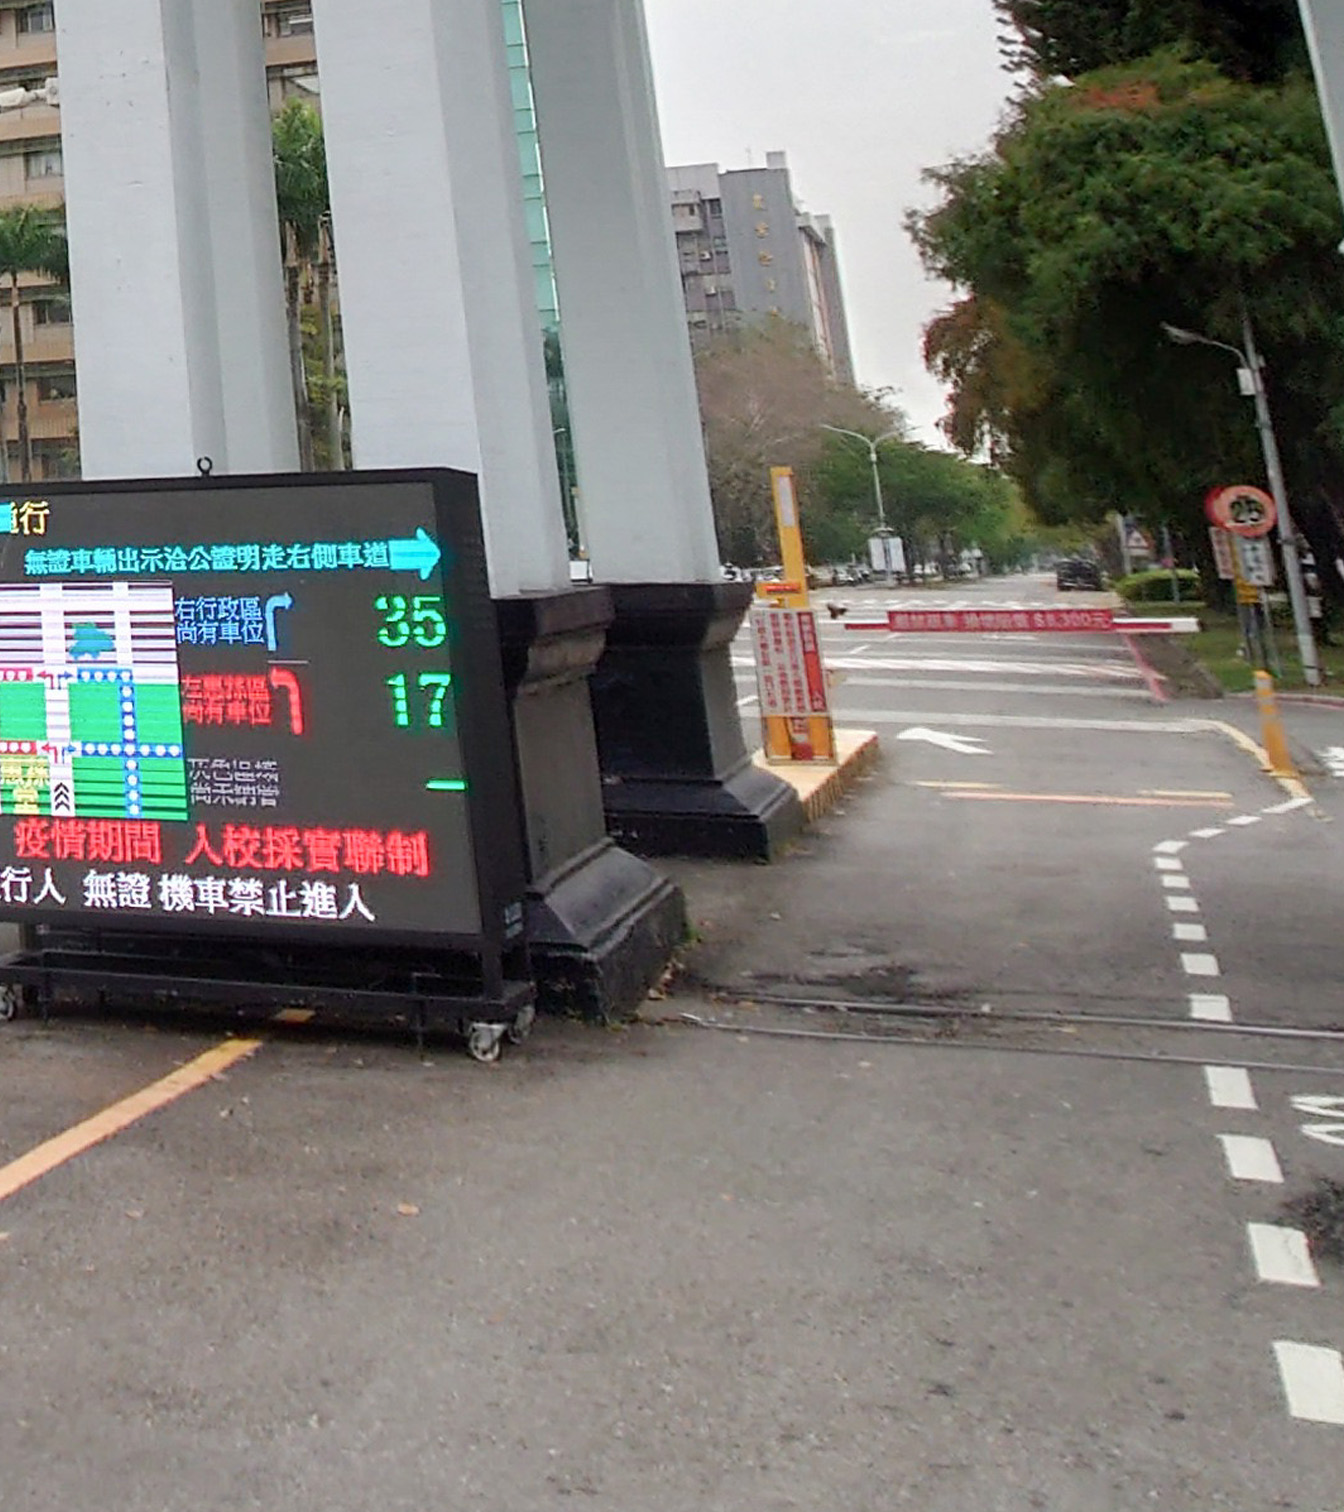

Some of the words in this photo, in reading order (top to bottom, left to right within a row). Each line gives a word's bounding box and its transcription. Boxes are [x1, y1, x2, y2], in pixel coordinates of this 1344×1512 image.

[175, 596, 264, 621] 右行政區
[176, 620, 265, 645] 尚有車位
[374, 594, 447, 648] 35
[385, 672, 452, 727] 17
[13, 817, 162, 865] 疫情期間
[183, 822, 431, 877] 入校採實聯制
